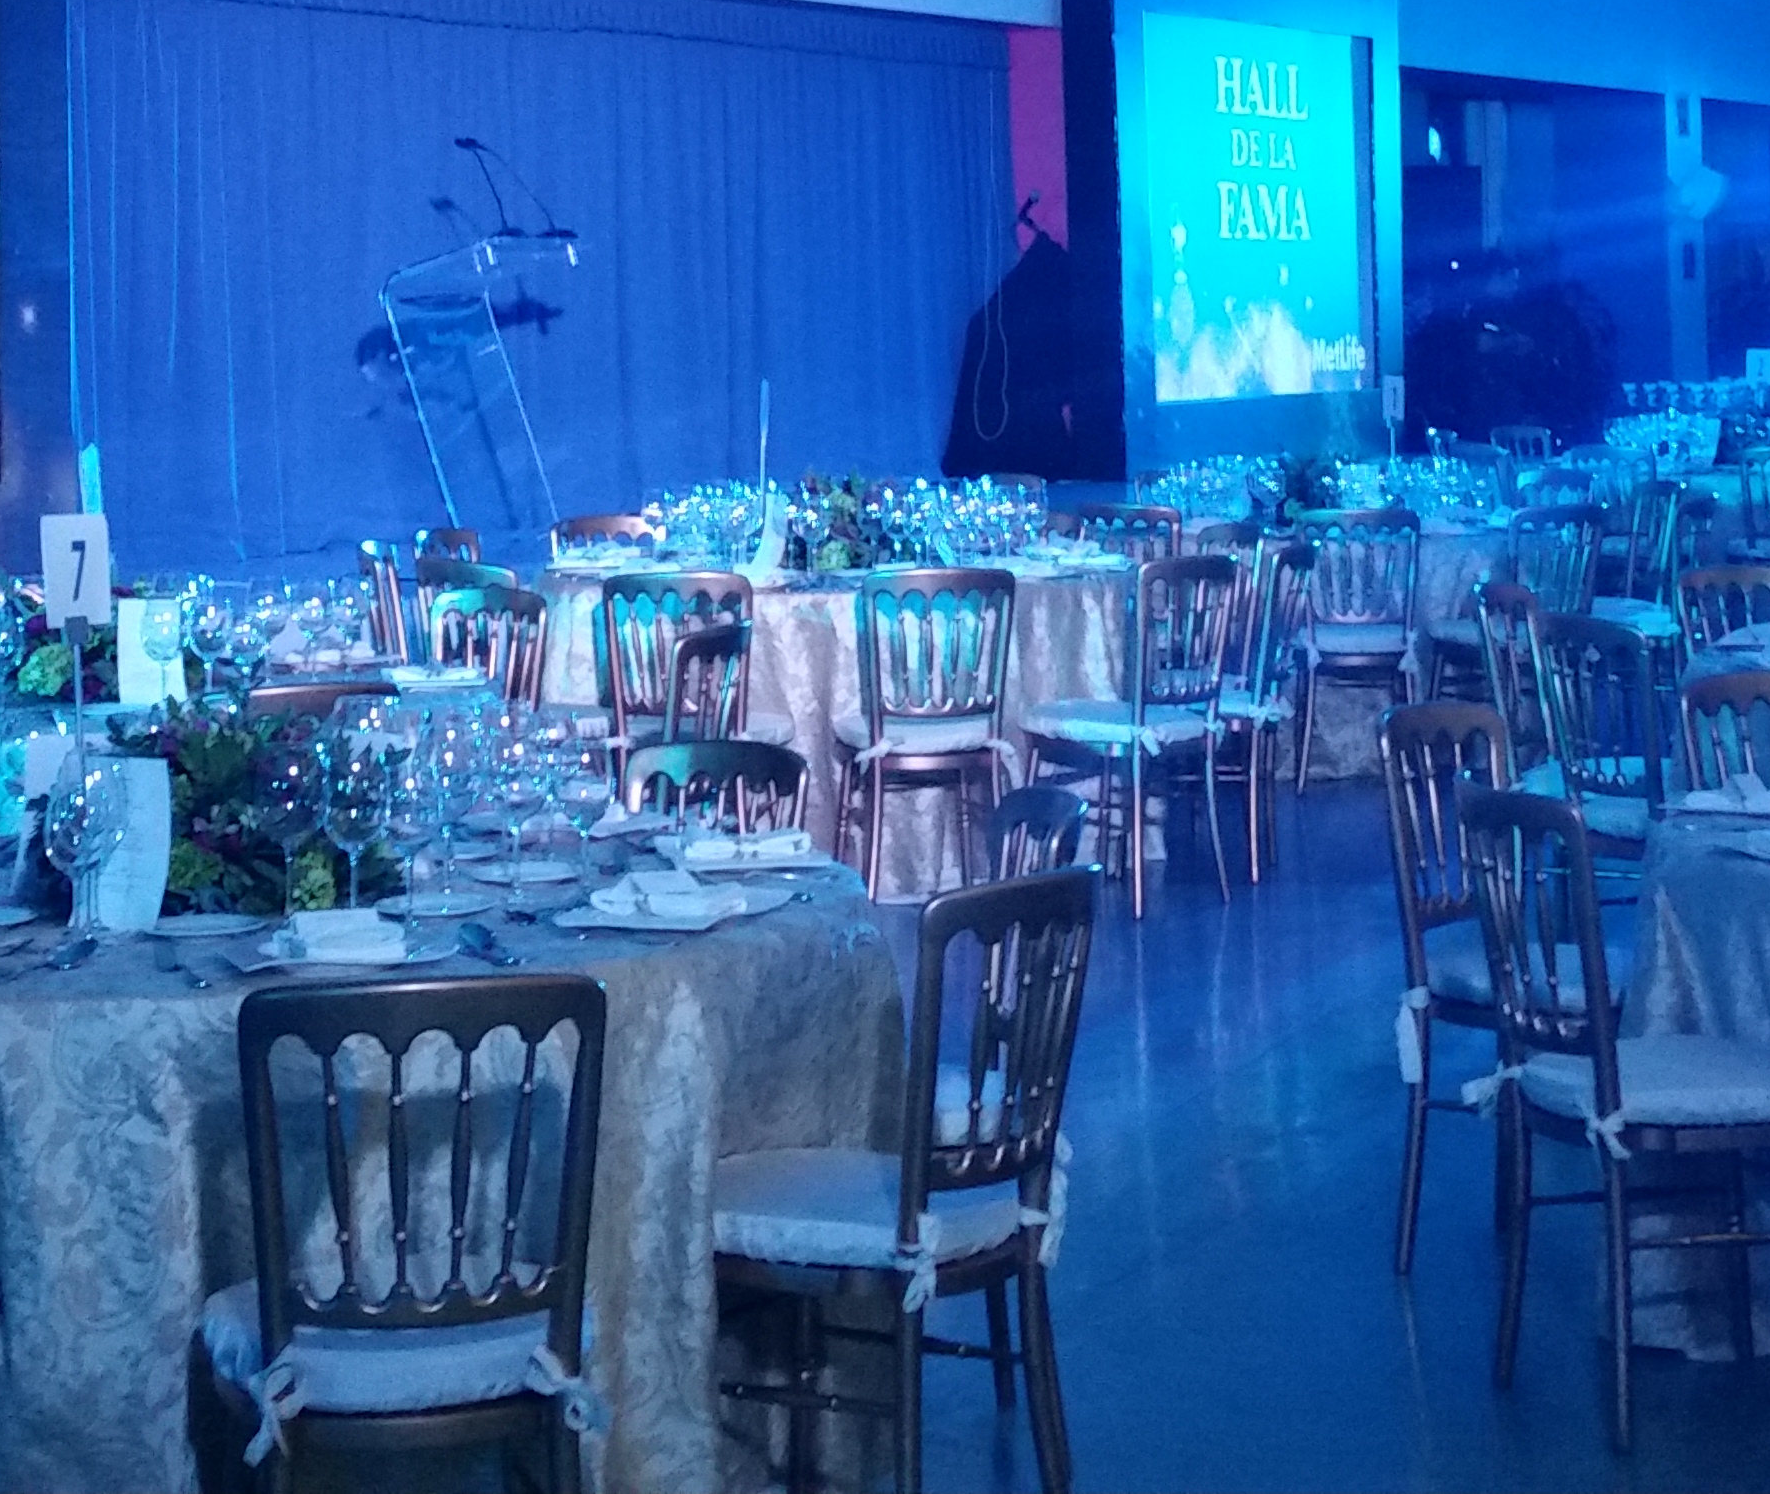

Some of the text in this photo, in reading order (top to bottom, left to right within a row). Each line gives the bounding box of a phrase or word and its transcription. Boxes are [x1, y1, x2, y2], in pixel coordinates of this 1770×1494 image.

[1213, 55, 1309, 121] HALL
[1231, 129, 1297, 171] DE LA
[1217, 181, 1312, 241] FAMA
[1311, 333, 1367, 373] MetLife
[70, 540, 87, 602] 7
